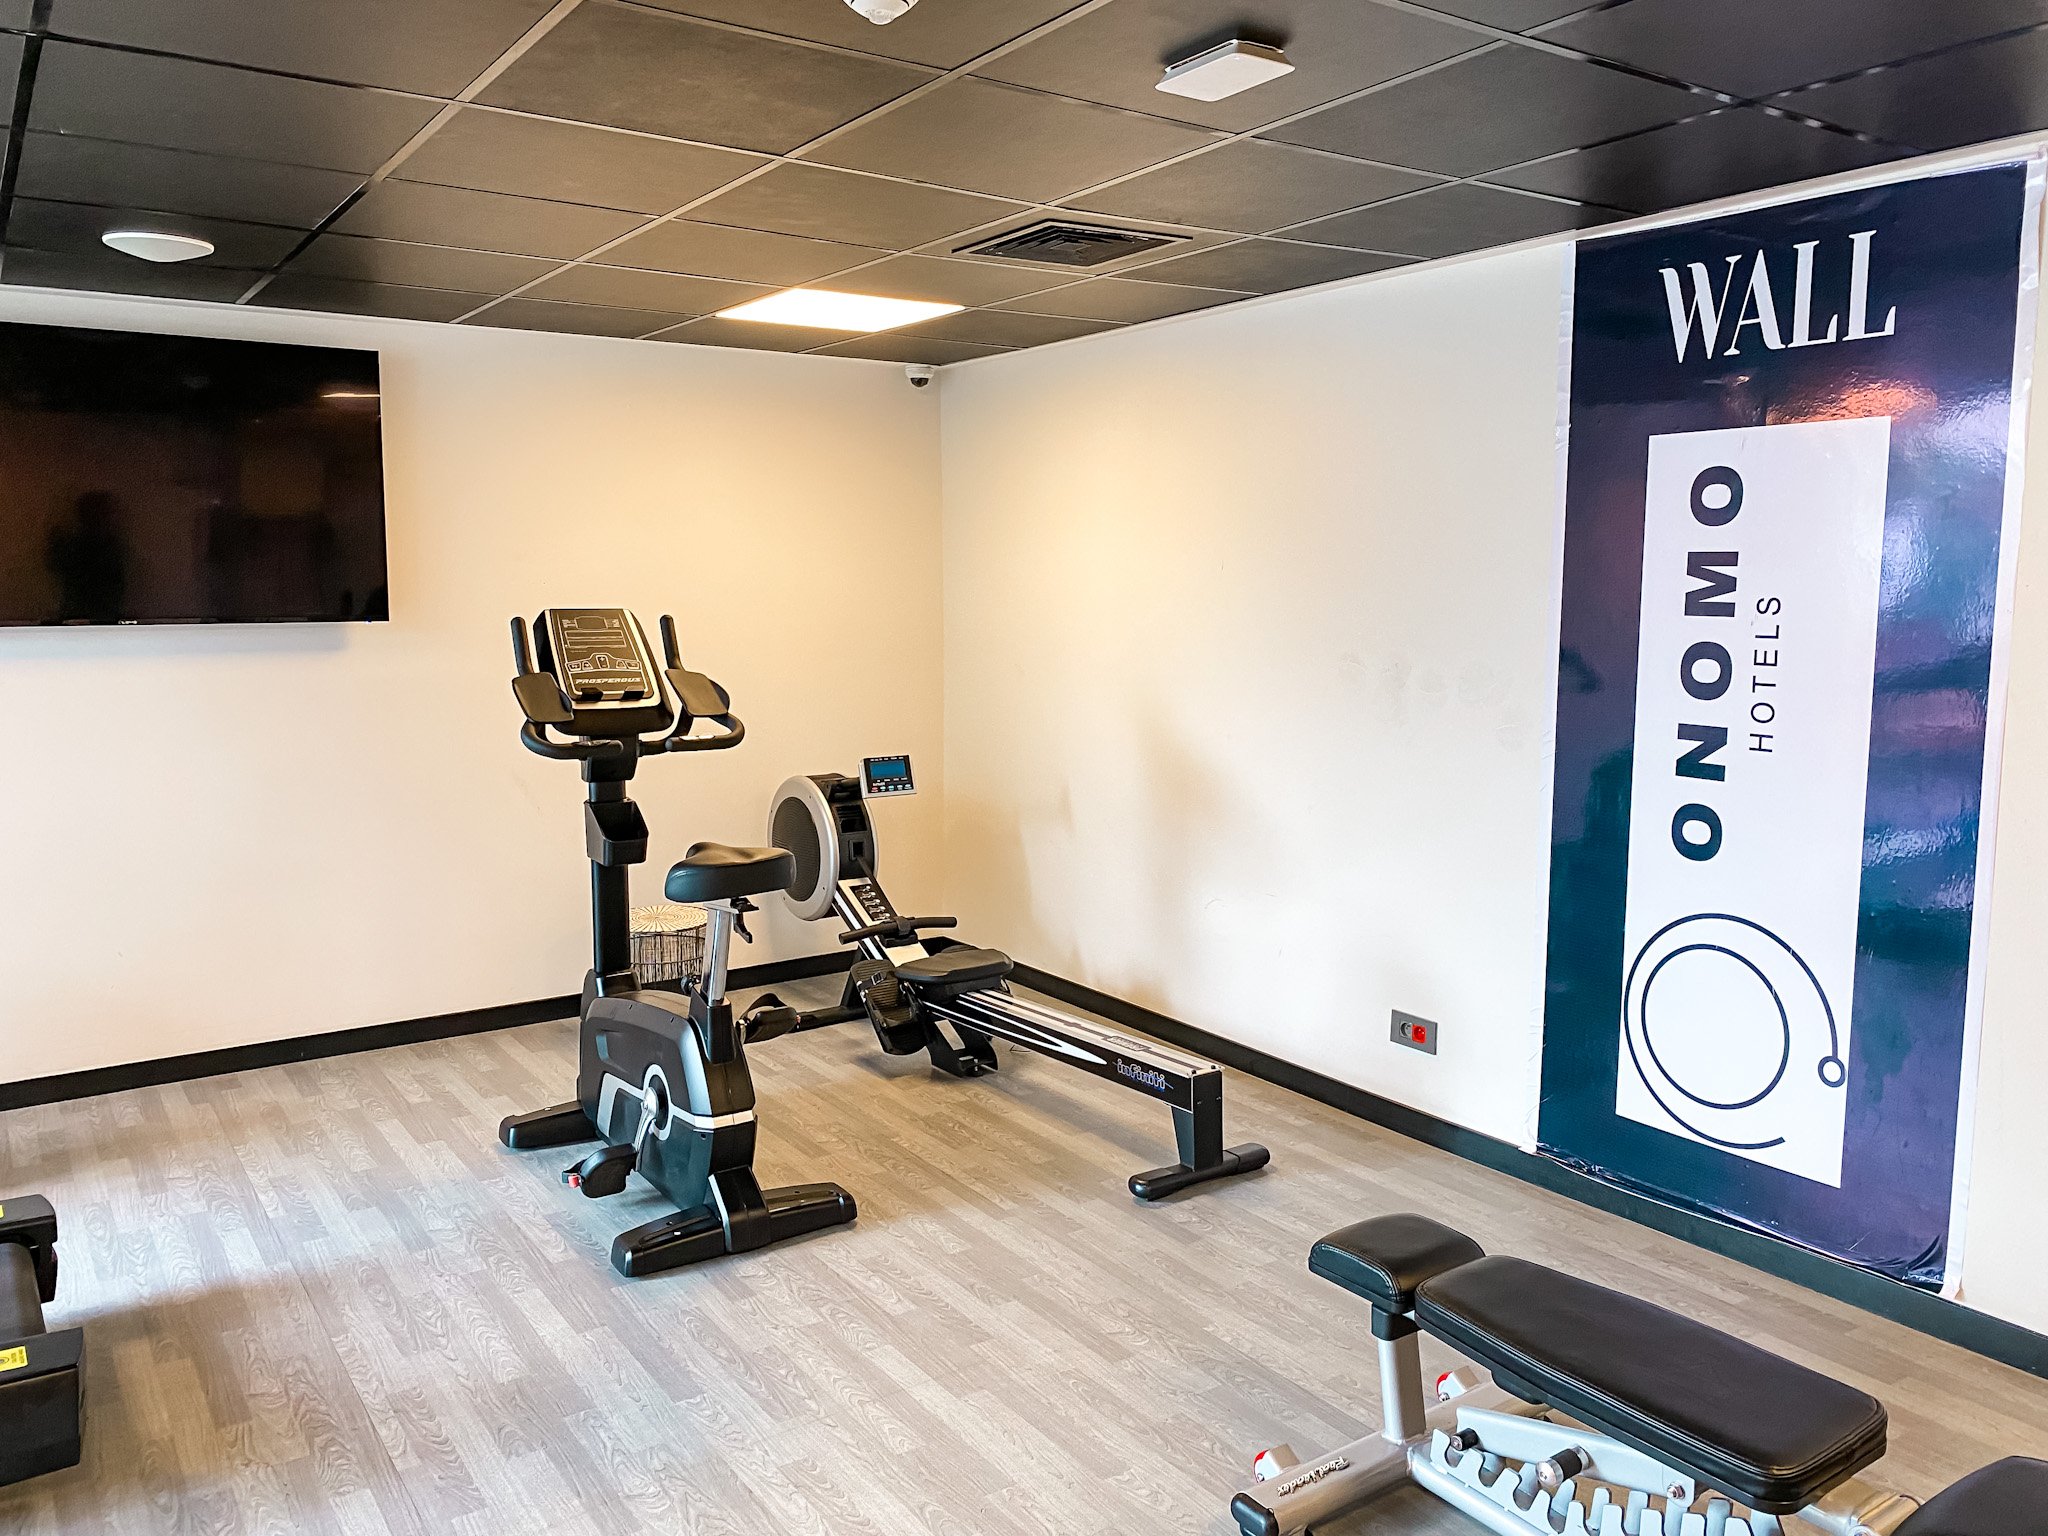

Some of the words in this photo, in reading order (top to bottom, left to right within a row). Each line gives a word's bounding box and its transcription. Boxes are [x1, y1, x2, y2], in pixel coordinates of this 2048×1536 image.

[1659, 230, 1897, 364] WALL
[575, 677, 642, 685] PROSPEROUS
[1671, 465, 1744, 862] ONOMO
[1748, 597, 1782, 753] HOTELS
